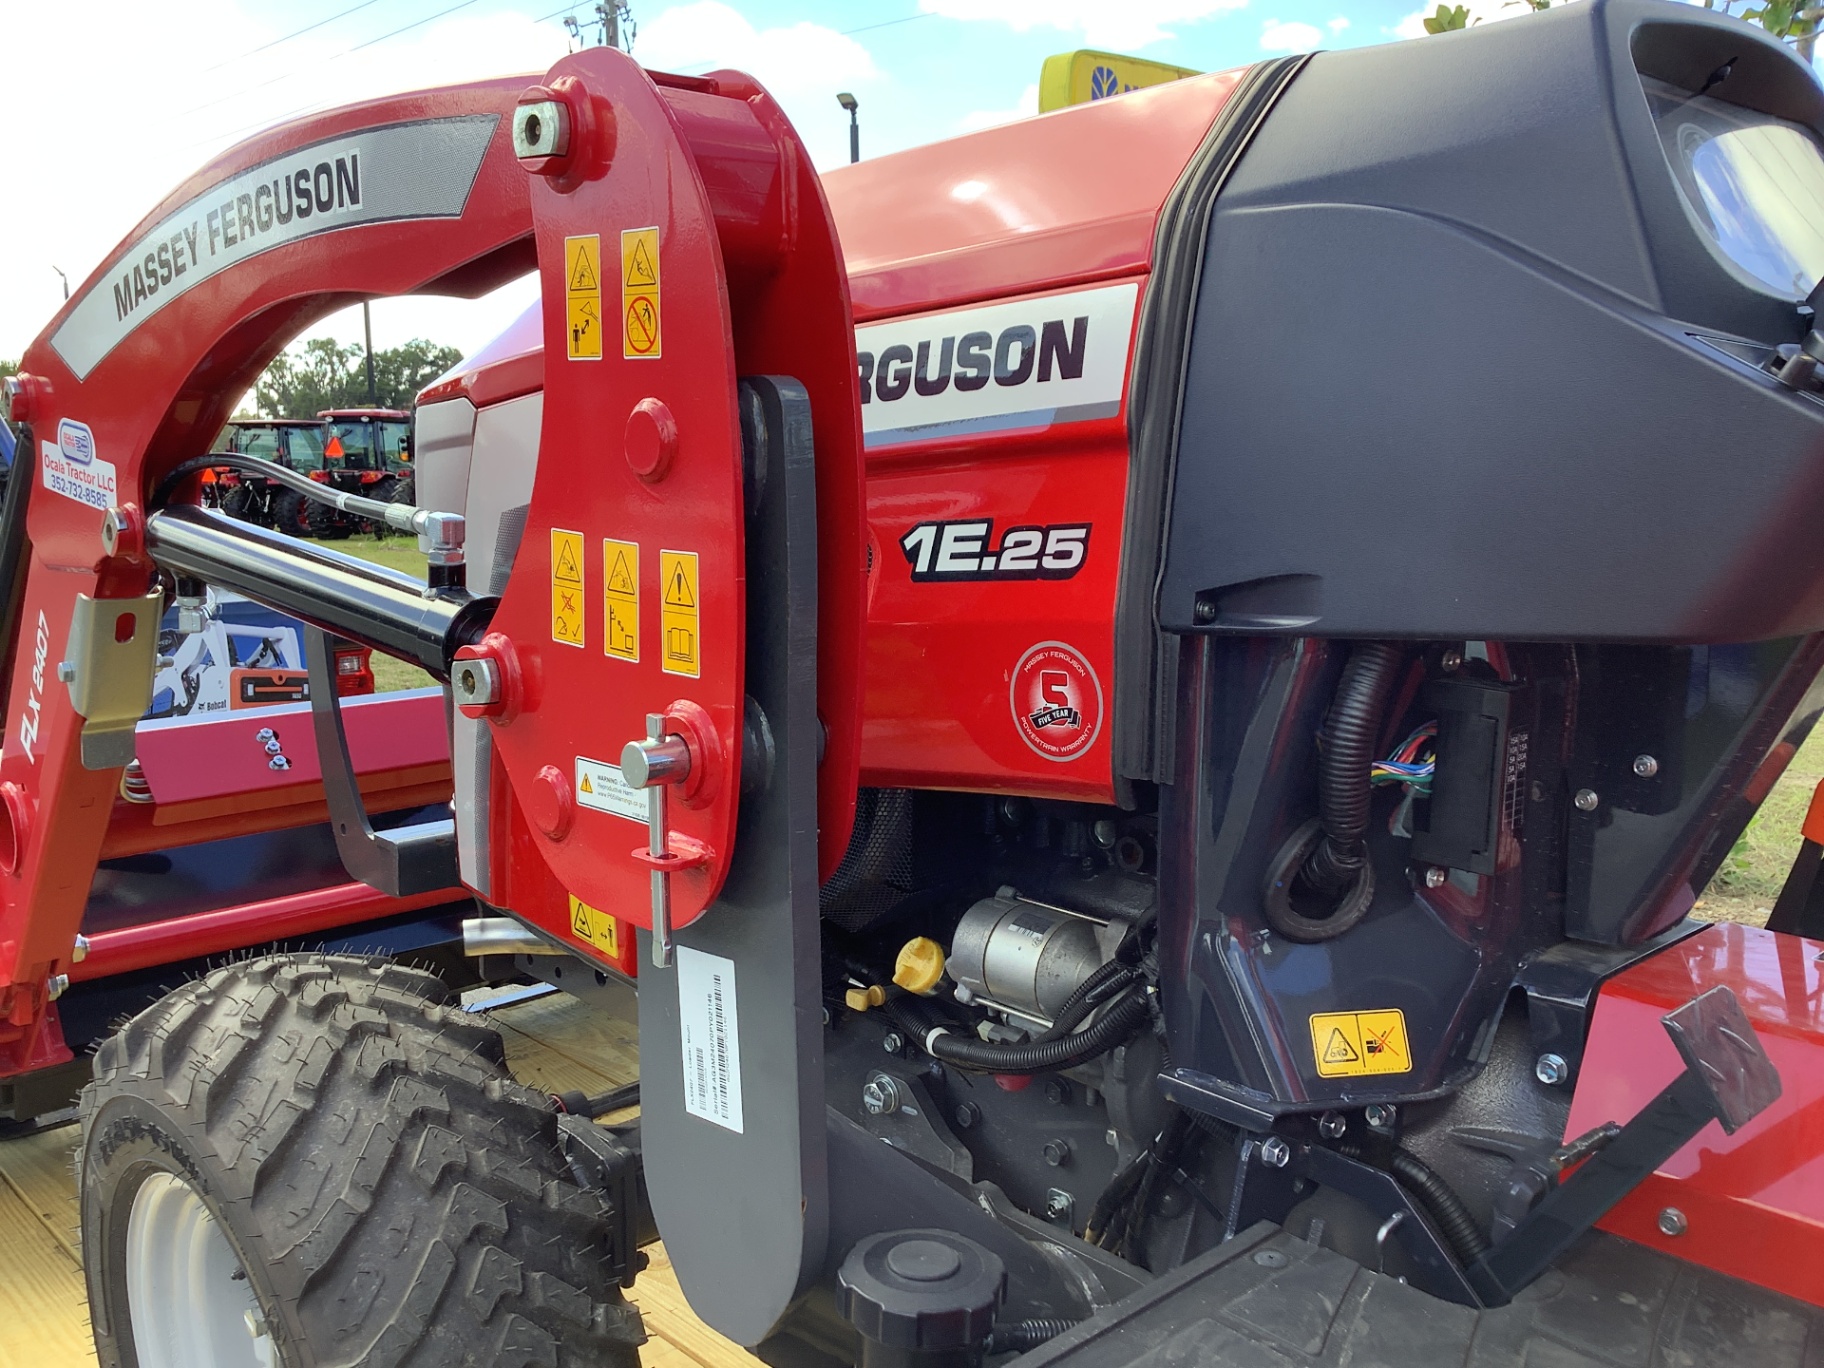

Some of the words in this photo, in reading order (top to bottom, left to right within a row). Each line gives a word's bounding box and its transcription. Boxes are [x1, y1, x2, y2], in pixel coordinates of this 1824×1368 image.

[113, 220, 199, 322] MASSEY
[206, 152, 362, 257] FERGUSON
[44, 454, 65, 475] Ocala
[66, 462, 96, 486] Tractor
[97, 473, 115, 493] LLC
[51, 474, 108, 508] 352-732-8585
[902, 522, 1088, 574] 1E.25
[1023, 651, 1049, 673] MASSEY
[1050, 651, 1086, 677] FERGUSON
[20, 686, 41, 766] FLX
[32, 608, 50, 696] 2407
[207, 700, 227, 712] Bobcat
[1040, 669, 1070, 727] 5
[1020, 716, 1060, 753] POWERTRAIN
[1060, 722, 1093, 753] WARRANTY
[1037, 714, 1052, 727] FIVE
[1052, 709, 1069, 719] YEAR
